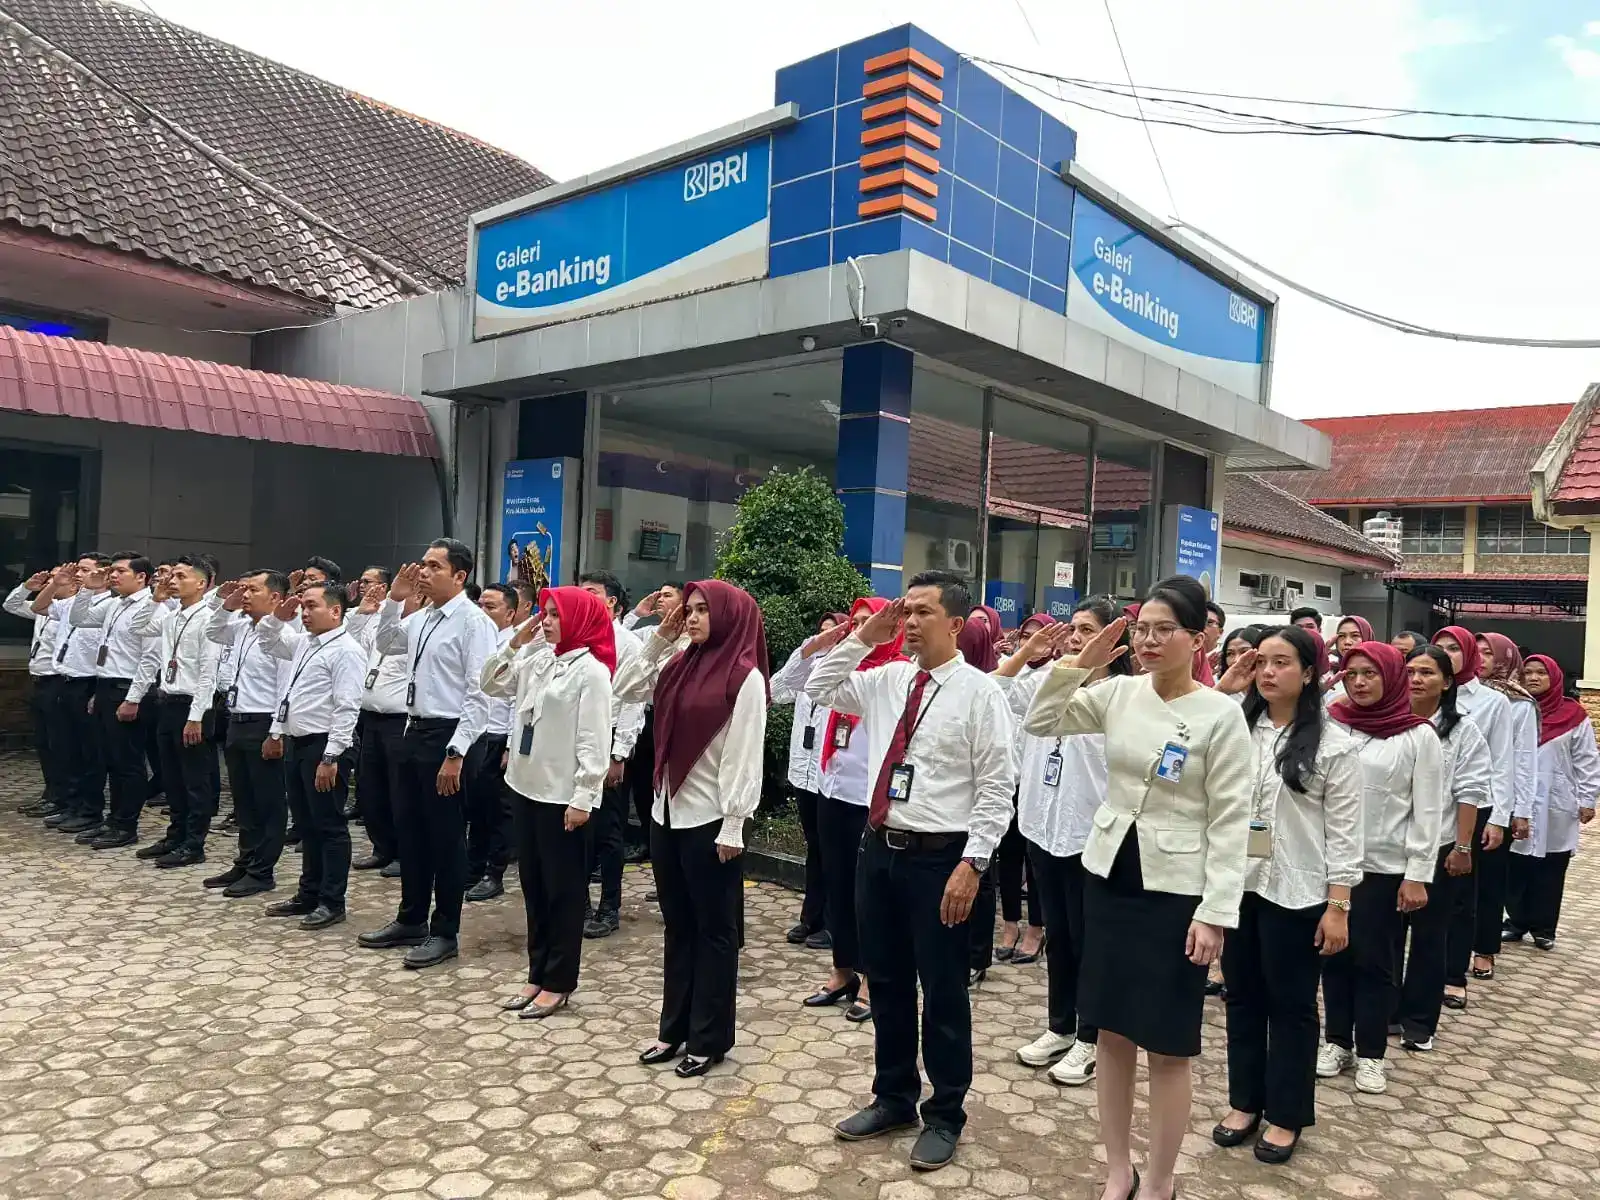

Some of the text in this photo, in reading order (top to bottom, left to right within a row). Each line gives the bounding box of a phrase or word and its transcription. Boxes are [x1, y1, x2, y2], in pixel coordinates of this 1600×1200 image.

[708, 151, 748, 192] BRI
[495, 240, 541, 271] Galeri
[1093, 236, 1132, 276] Galeri
[495, 253, 610, 302] e-Banking
[1092, 270, 1180, 339] e-Banking
[1241, 303, 1257, 329] BRI
[1002, 598, 1015, 612] BRI
[1059, 603, 1071, 616] BRI
